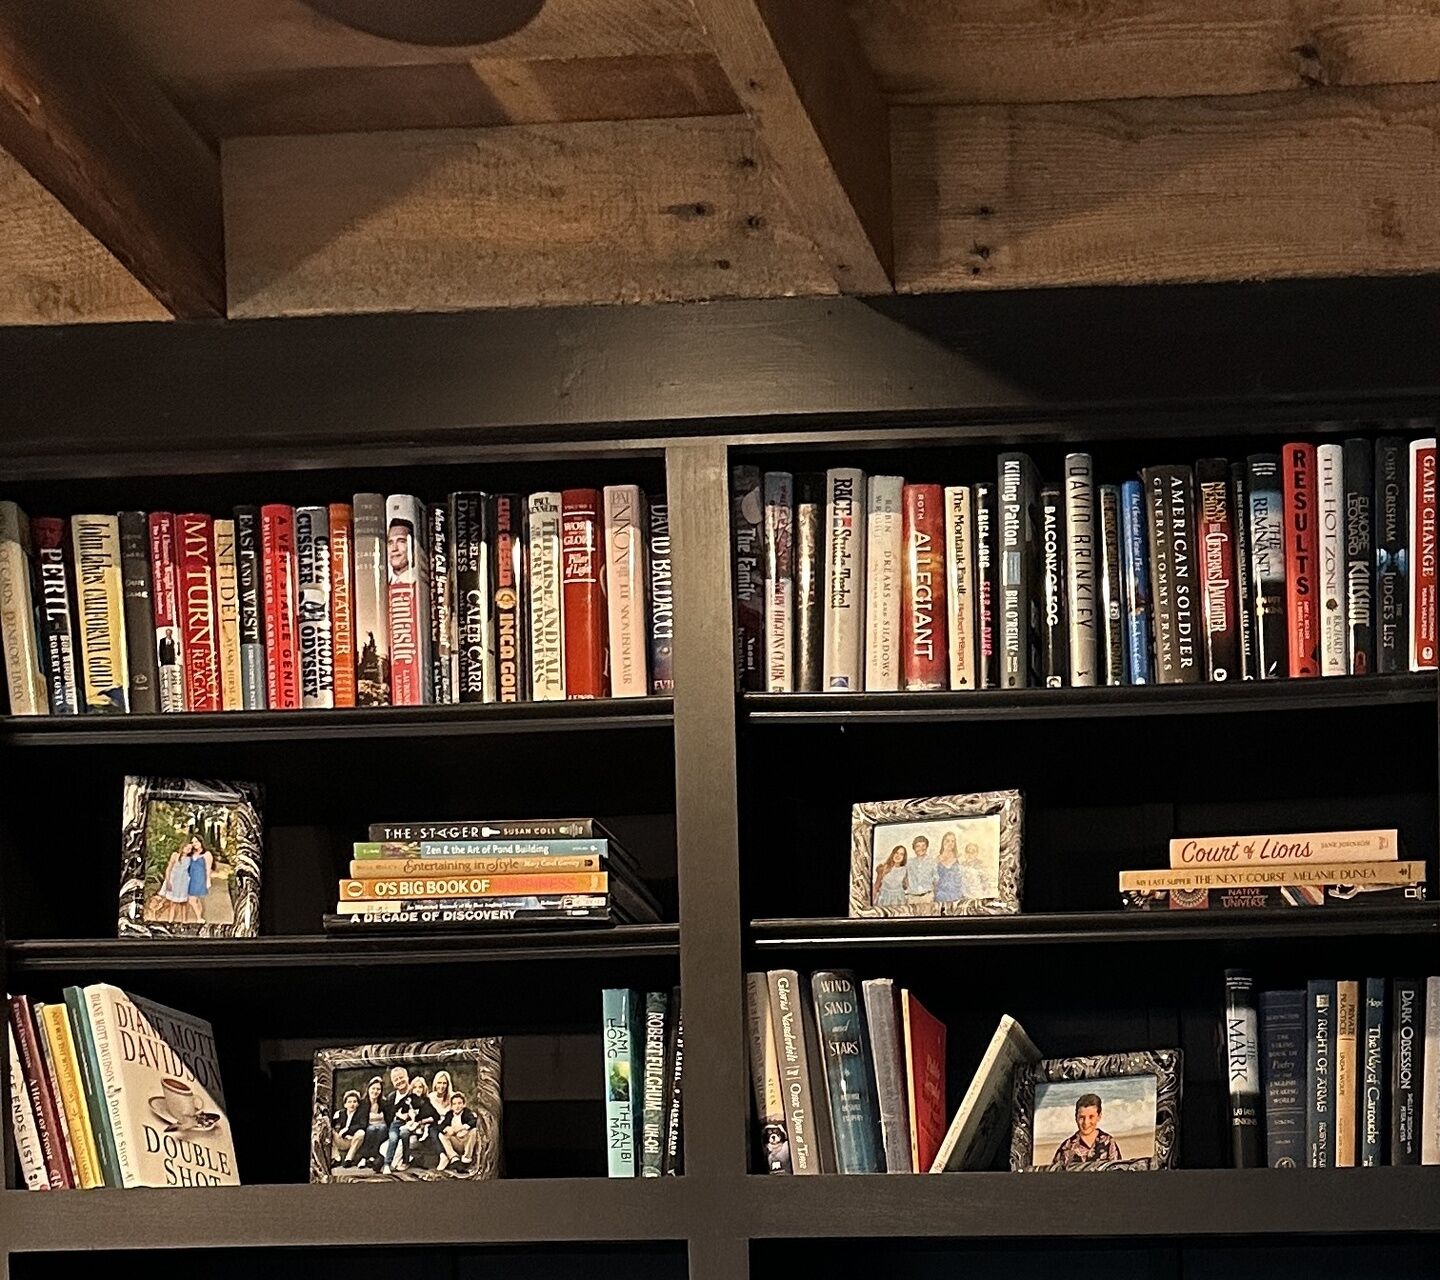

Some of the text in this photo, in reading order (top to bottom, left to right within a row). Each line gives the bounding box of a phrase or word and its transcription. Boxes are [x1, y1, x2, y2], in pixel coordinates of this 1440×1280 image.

[833, 477, 852, 516] RACE
[917, 493, 925, 520] ROTH
[1003, 460, 1020, 502] Killing
[1385, 447, 1399, 541] JOHN GRISHAM
[954, 489, 966, 596] The Montauk Fault
[1005, 503, 1020, 546] Patton
[1324, 453, 1336, 595] THE HOT ZONE
[1422, 455, 1434, 577] GAME CHANGE
[40, 547, 68, 621] PERIL
[184, 519, 212, 643] MY TURN
[218, 533, 236, 631] INFIDEL
[238, 513, 257, 640] EAST AND WEST
[651, 503, 672, 638] DAVID BALDACCI
[737, 527, 756, 601] The Family
[913, 529, 932, 661] ALLEGIANT
[1153, 476, 1172, 671] GENERAL TOMMY FRANKS
[1170, 475, 1193, 669] AMERICAN SOLDIER
[391, 587, 416, 664] Fantastic
[467, 589, 482, 692] CALEB CARR
[425, 843, 549, 854] Zen & the Art of Pond Building
[503, 826, 556, 835] SUSAN COLL
[1181, 837, 1314, 863] Court of Lions
[374, 879, 490, 895] O'S BIG BOOK OF
[403, 859, 472, 873] Entertaining
[474, 860, 484, 870] in
[486, 857, 519, 872] Style
[1228, 887, 1261, 896] NATIVE
[351, 908, 516, 924] A DECADE OF DISCOVERY
[1223, 897, 1267, 908] UNIVERSE
[823, 1000, 853, 1016] SAND
[1347, 1002, 1355, 1035] PRIVATE
[1400, 989, 1415, 1089] DARK OBSESSION
[646, 1011, 663, 1110] ROBERT FULGHUM
[828, 1039, 859, 1056] STARS
[1228, 1018, 1248, 1083] MARK
[1247, 1038, 1256, 1060] THE
[1315, 1018, 1327, 1112] RIGHT OF ARMS
[143, 1124, 231, 1176] DOUBLE
[610, 1117, 620, 1149] MAN
[620, 1103, 631, 1163] THE ALIBI
